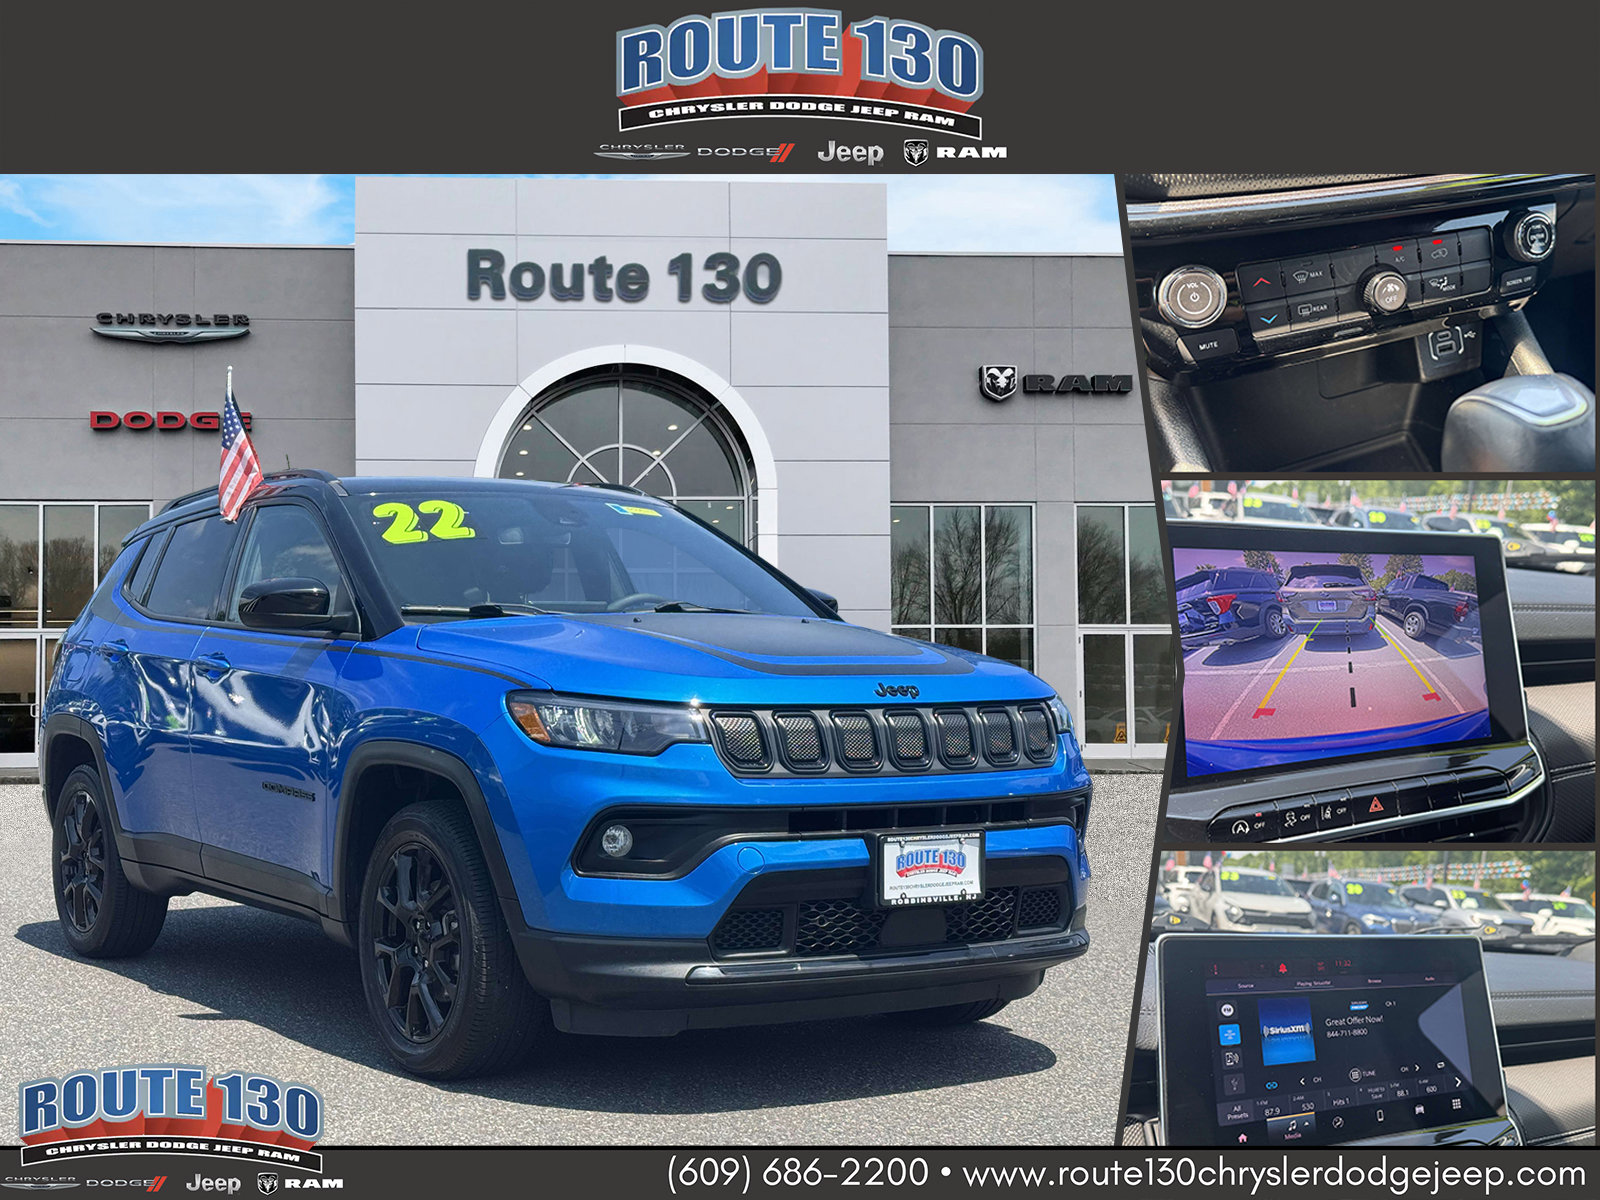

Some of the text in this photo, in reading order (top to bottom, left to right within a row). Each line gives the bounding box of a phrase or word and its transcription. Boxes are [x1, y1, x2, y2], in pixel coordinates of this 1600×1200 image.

[467, 248, 783, 304] Route 130
[1309, 270, 1323, 278] MAX
[1385, 294, 1398, 304] OFF
[1313, 304, 1328, 312] REAR
[96, 312, 250, 325] CHRYSLER
[1199, 341, 1219, 350] MUTE
[1023, 374, 1133, 394] RAM
[372, 500, 476, 544] 22
[874, 682, 920, 699] Jeep
[1336, 807, 1347, 815] OFF
[1299, 813, 1311, 821] OFF
[1253, 821, 1265, 829] OFF
[896, 848, 966, 870] ROUTE 130
[1325, 1015, 1384, 1027] Great Offer Now!
